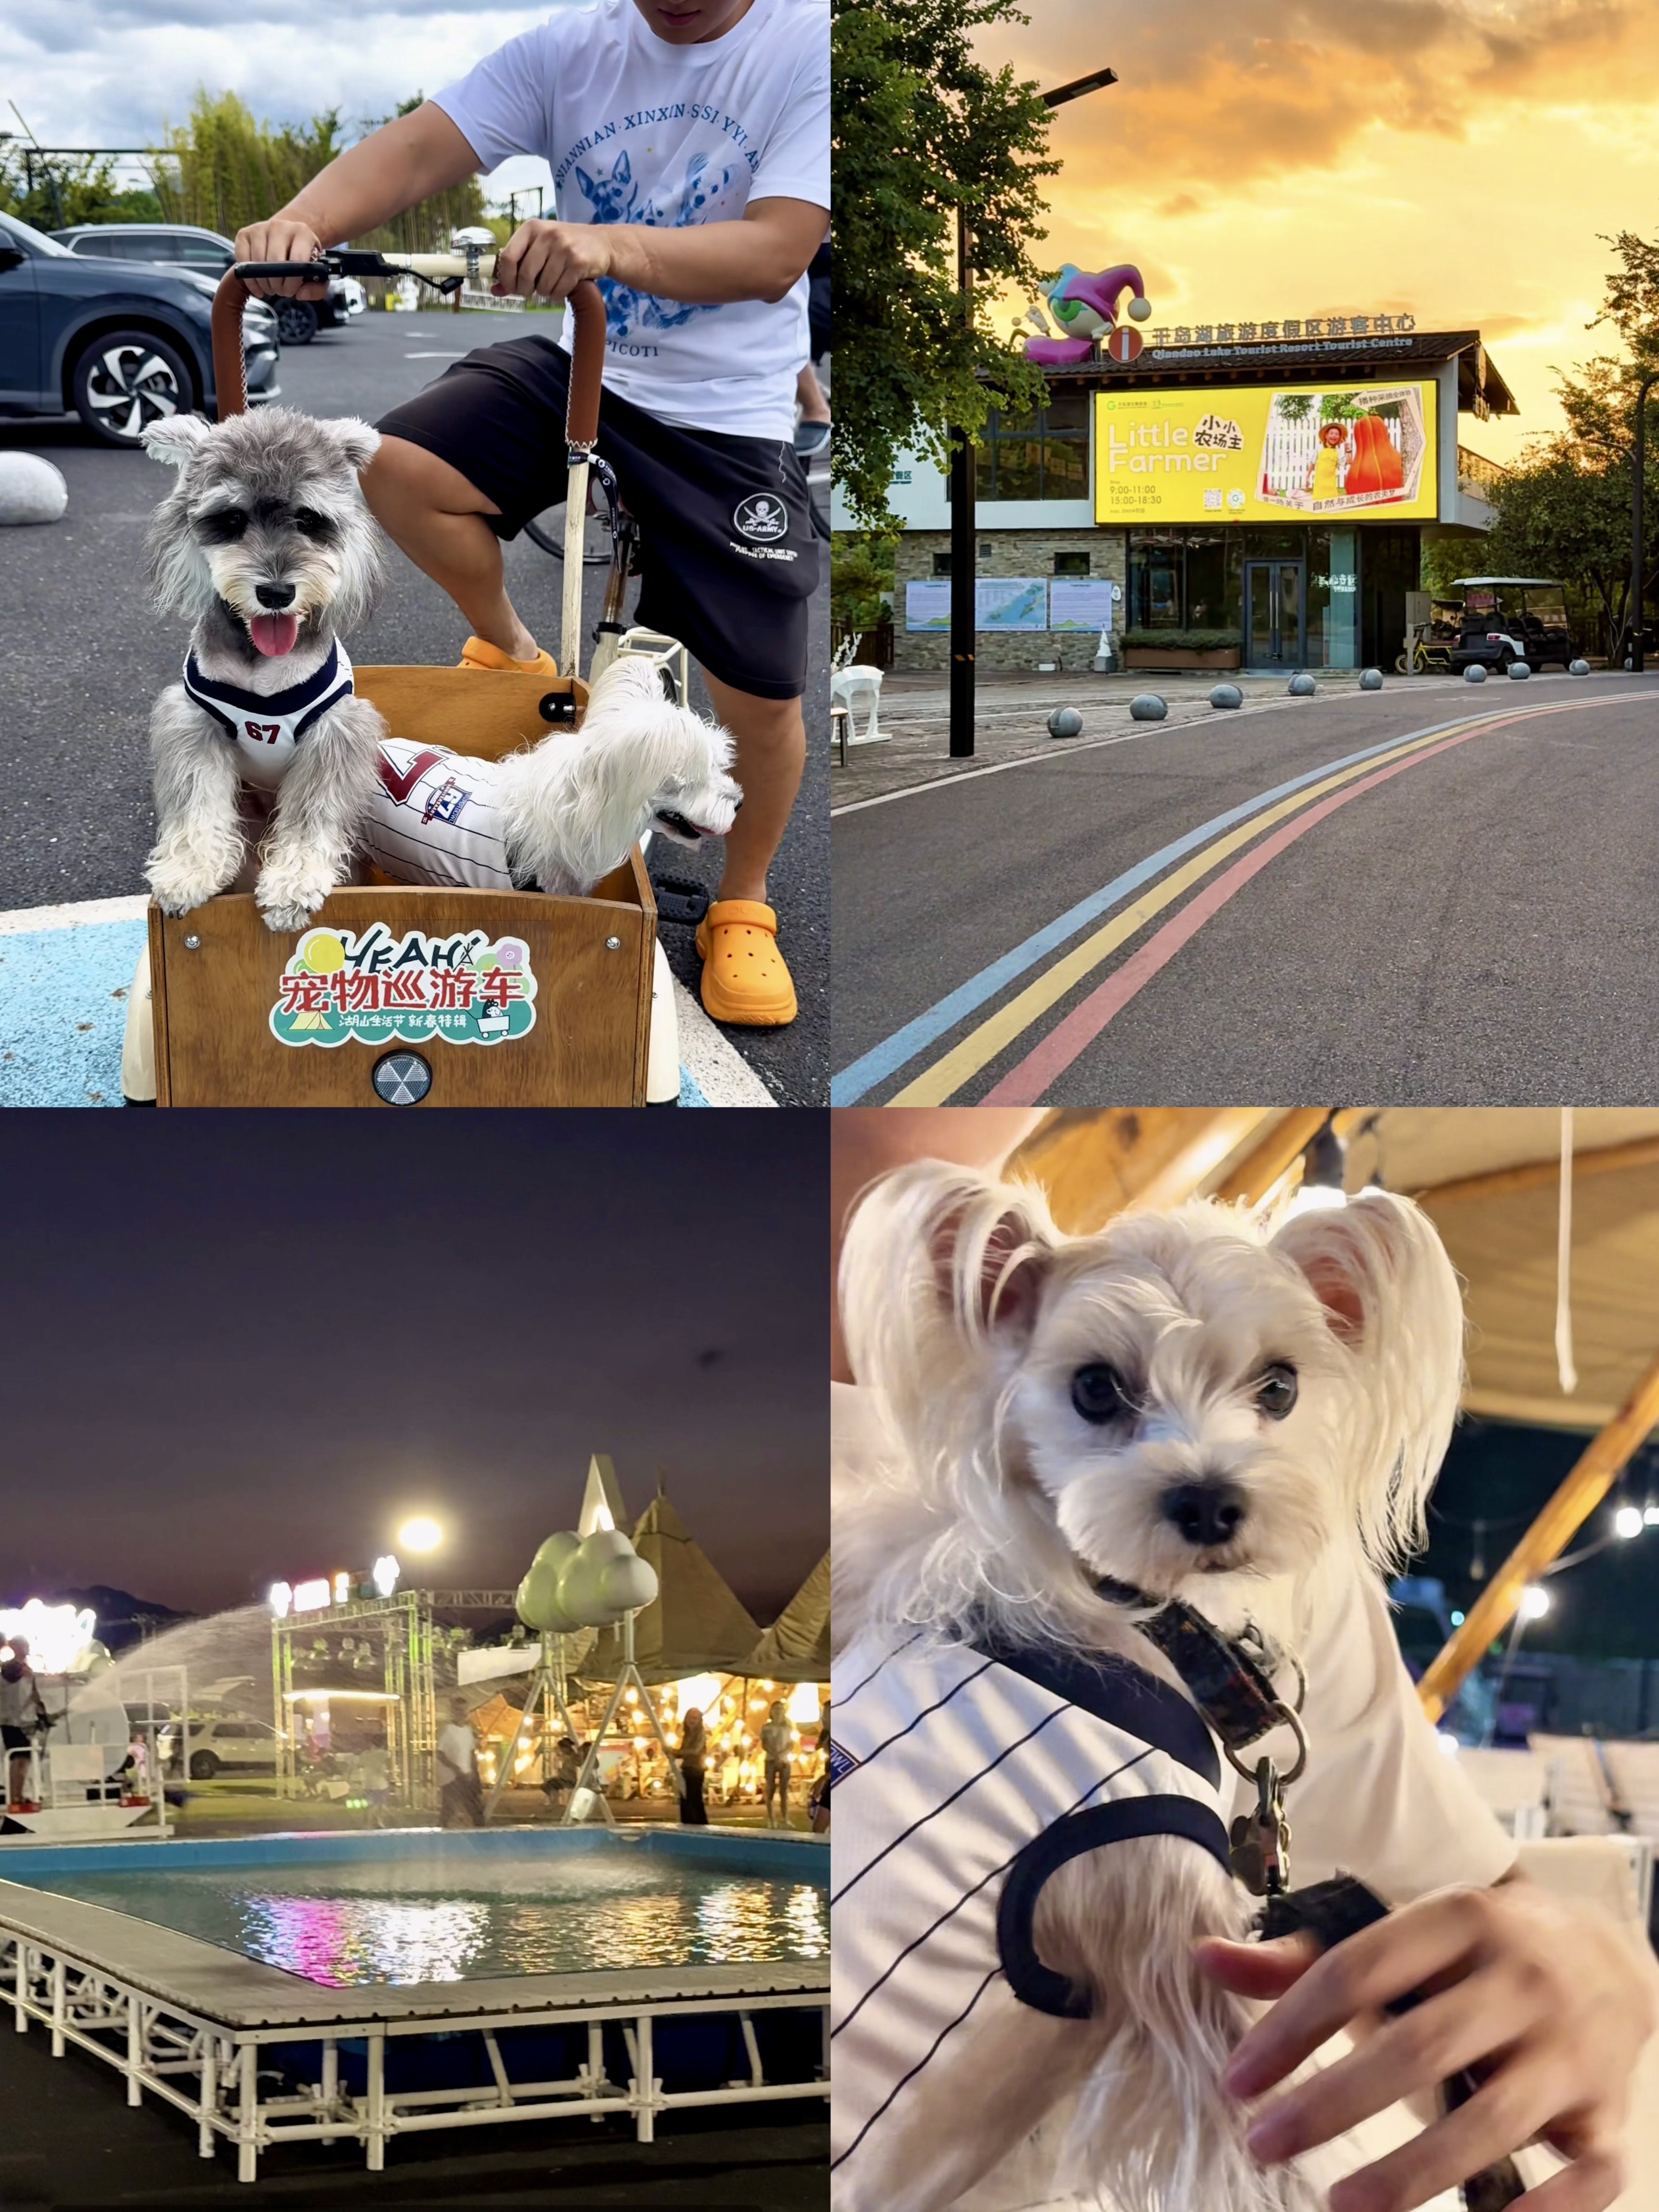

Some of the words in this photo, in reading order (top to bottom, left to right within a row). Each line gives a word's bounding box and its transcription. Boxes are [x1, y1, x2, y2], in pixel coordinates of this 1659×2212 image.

[556, 122, 615, 183] NIANNIAN
[624, 104, 685, 130] XINXIN
[1152, 312, 1416, 347] 千岛湖旅游度假区游客中心
[1152, 349, 1201, 360] Qiandao
[1204, 347, 1231, 357] Lake
[1234, 345, 1277, 355] Tourist
[1280, 343, 1319, 353] Resort
[1323, 340, 1367, 350] Tourist
[1371, 338, 1413, 347] Centre
[1109, 419, 1189, 447] Little
[1194, 430, 1242, 450] 农场主
[1109, 449, 1227, 473] Farmer
[1110, 485, 1155, 494] 9:00-11:00
[1110, 495, 1162, 505] 15:00-18:30
[245, 721, 281, 744] 67
[282, 967, 525, 1013] 宠物巡游车
[339, 1014, 405, 1027] 湖山生活节
[409, 1014, 467, 1028] 新春特辑
